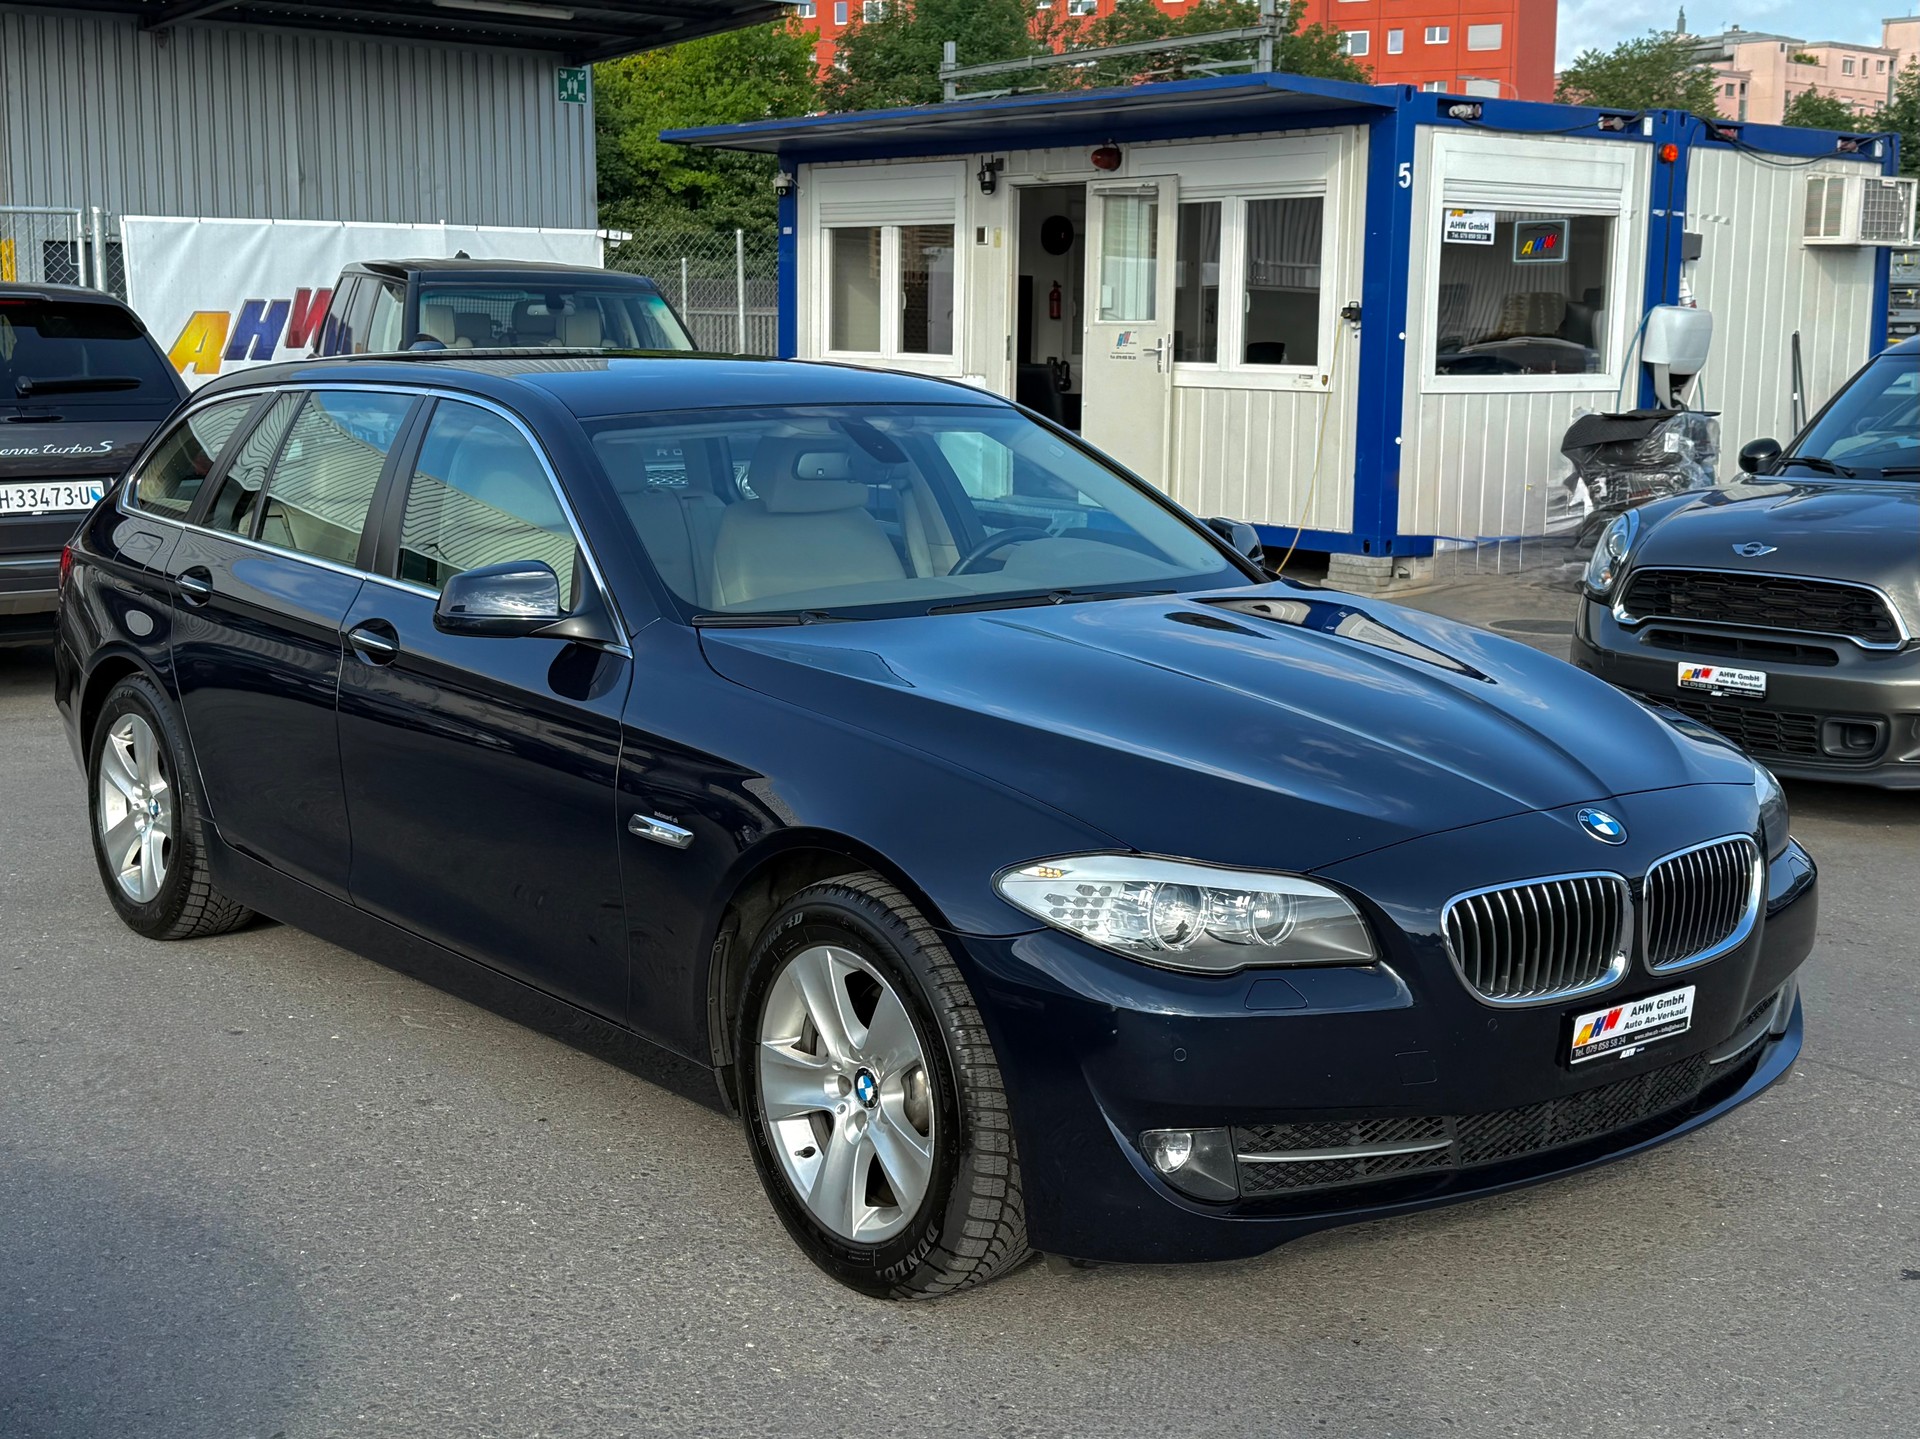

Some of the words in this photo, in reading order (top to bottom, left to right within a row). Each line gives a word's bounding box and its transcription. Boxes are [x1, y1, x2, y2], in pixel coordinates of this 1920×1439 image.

[1399, 162, 1411, 189] 5
[1450, 221, 1467, 230] AHW
[1468, 223, 1489, 232] GmbH
[43, 443, 92, 454] turbo
[90, 440, 114, 454] S
[1718, 670, 1737, 678] AHW
[1738, 673, 1760, 682] GmbH
[785, 911, 803, 929] 4D
[1630, 1002, 1655, 1018] AHW
[1656, 993, 1686, 1010] GmbH
[1574, 1007, 1623, 1046] AHW
[1623, 1020, 1643, 1031] Auto
[1644, 1006, 1688, 1024] An-Verkauf
[1575, 1046, 1584, 1057] Tel.
[1585, 1043, 1597, 1054] 079
[1618, 1035, 1627, 1046] 24
